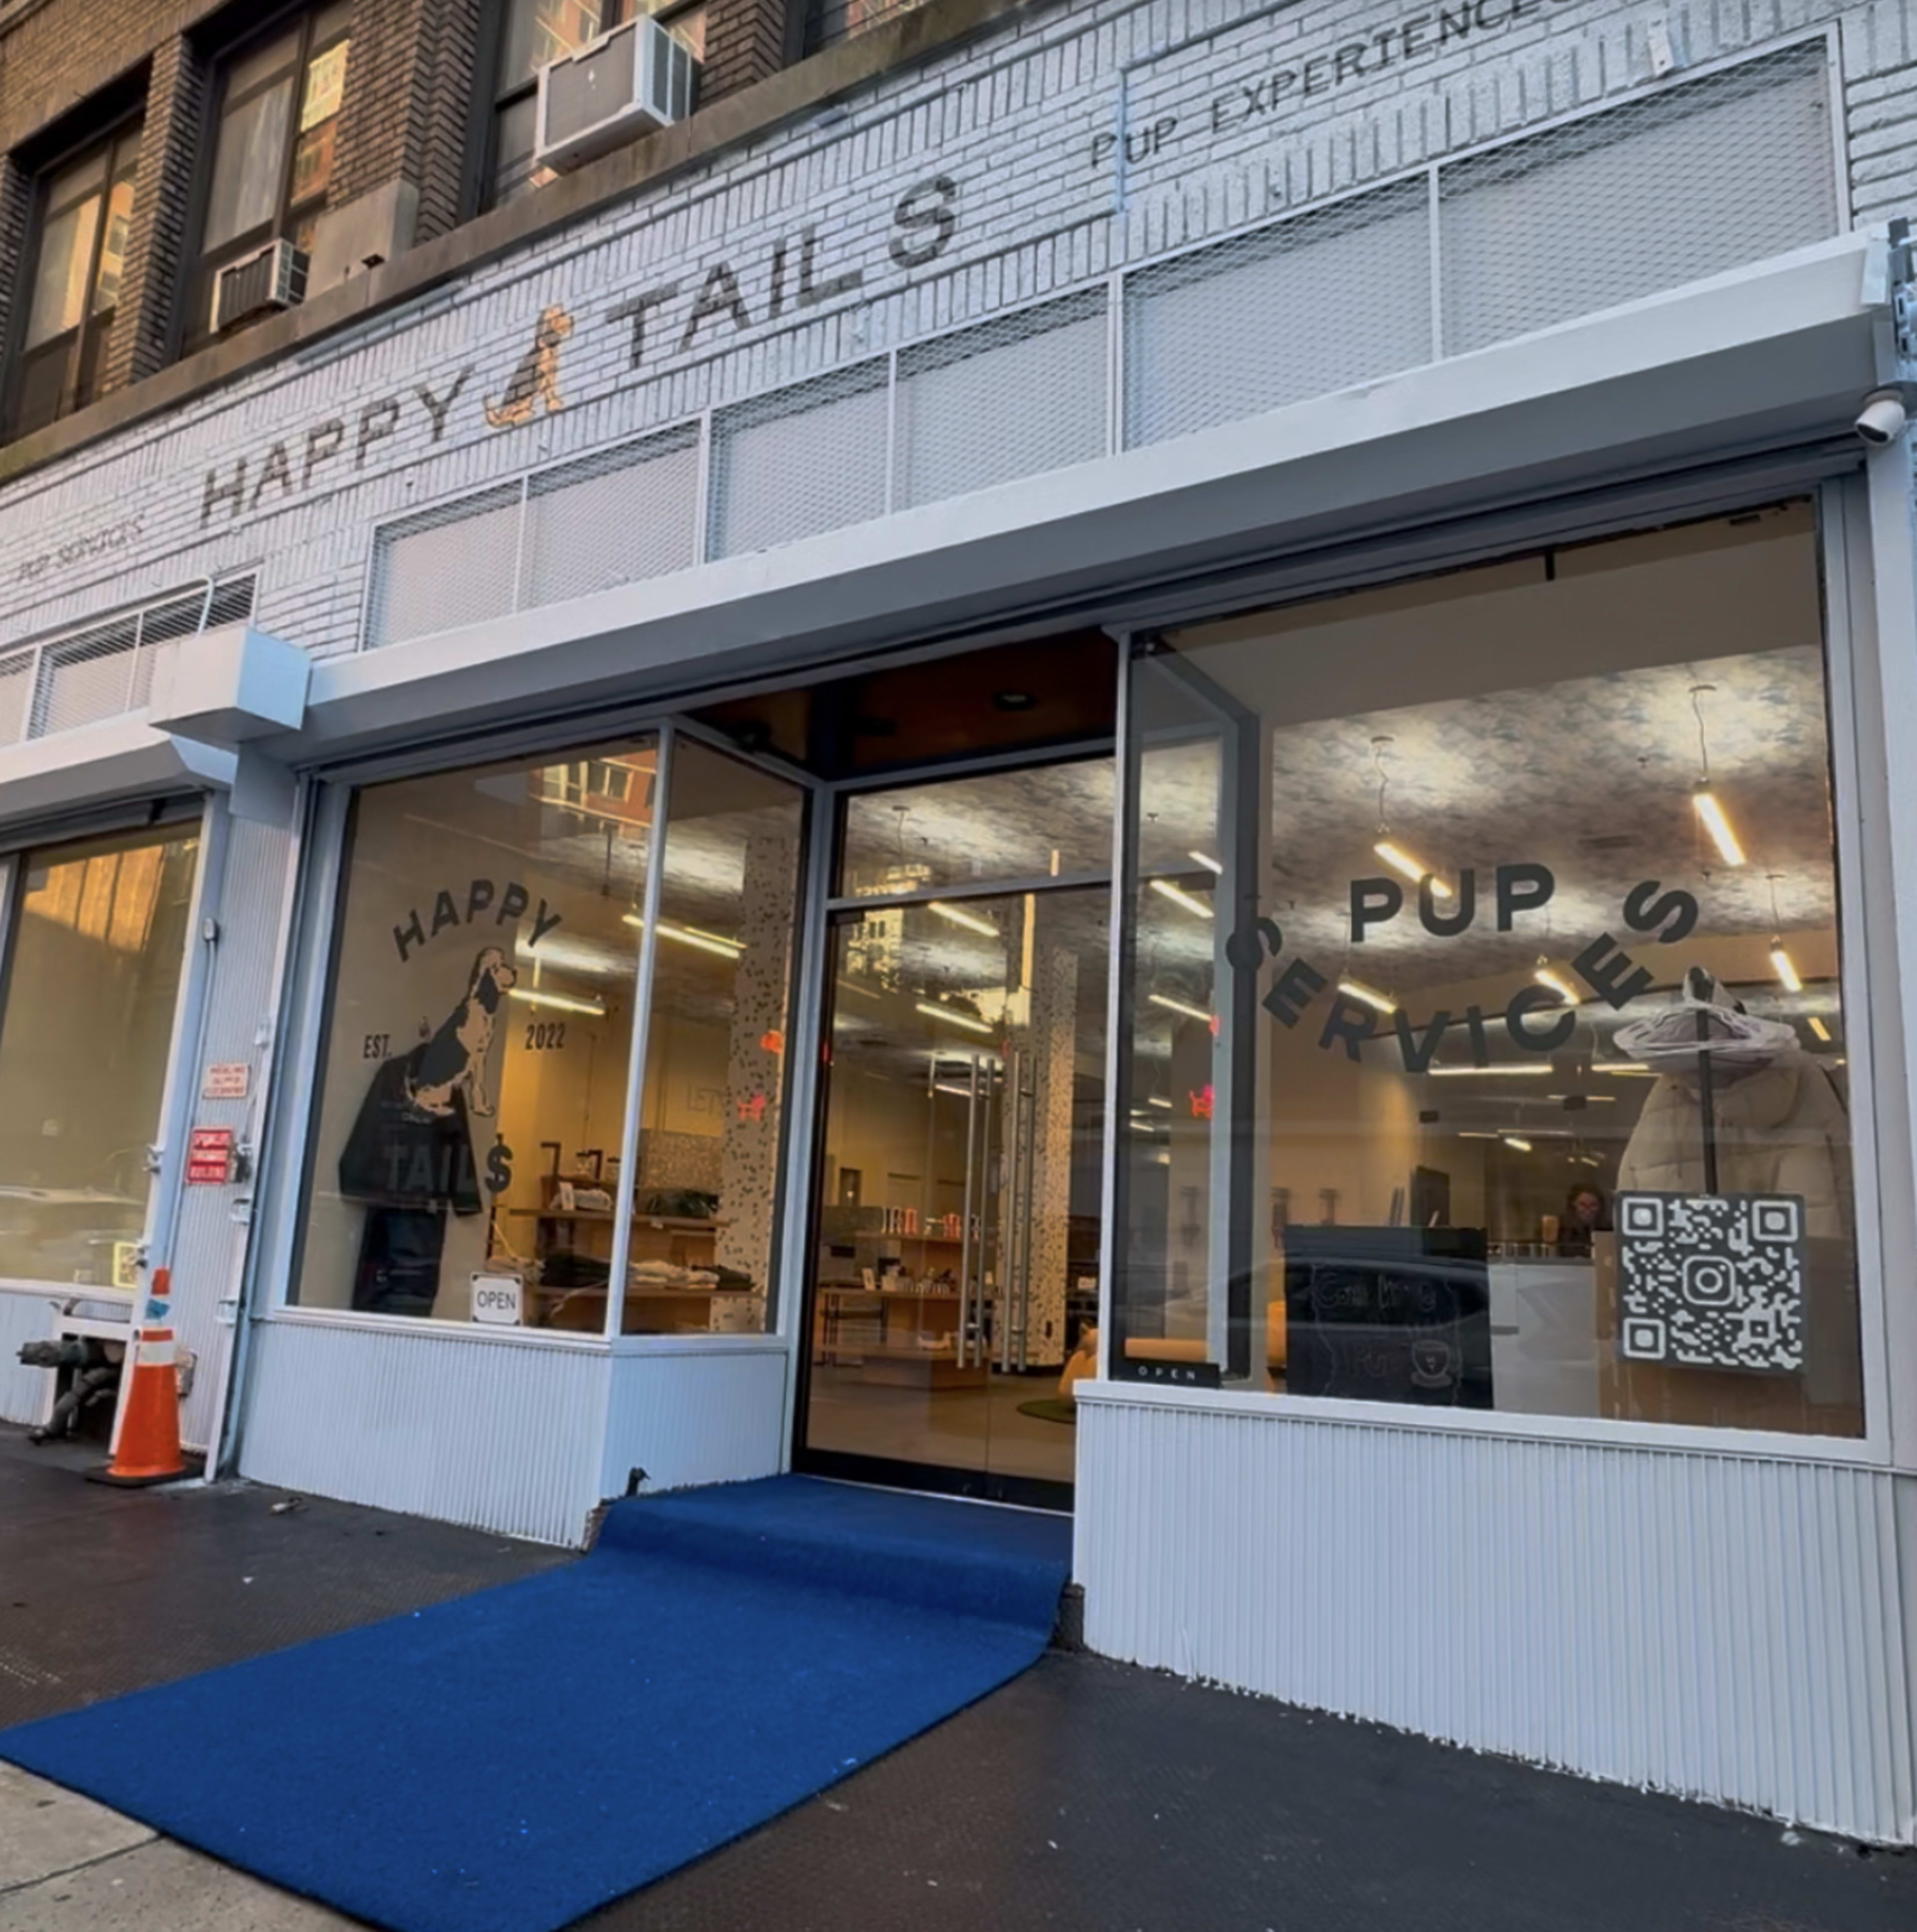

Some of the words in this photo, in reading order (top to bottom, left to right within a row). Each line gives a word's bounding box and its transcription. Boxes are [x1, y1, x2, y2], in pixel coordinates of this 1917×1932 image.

[1091, 116, 1178, 168] PUP
[1213, 0, 1569, 133] EXPERIENCE
[199, 365, 475, 529] HAPPY
[607, 175, 957, 369] TAILS
[393, 879, 562, 962] HAPPY
[1350, 863, 1555, 942] PUP
[1226, 880, 1698, 1074] SERVICES
[363, 1034, 392, 1059] EST.
[526, 1023, 566, 1050] 2022
[381, 1142, 514, 1193] TAILS
[477, 1290, 516, 1310] OPEN
[1138, 1365, 1195, 1380] OPEN
